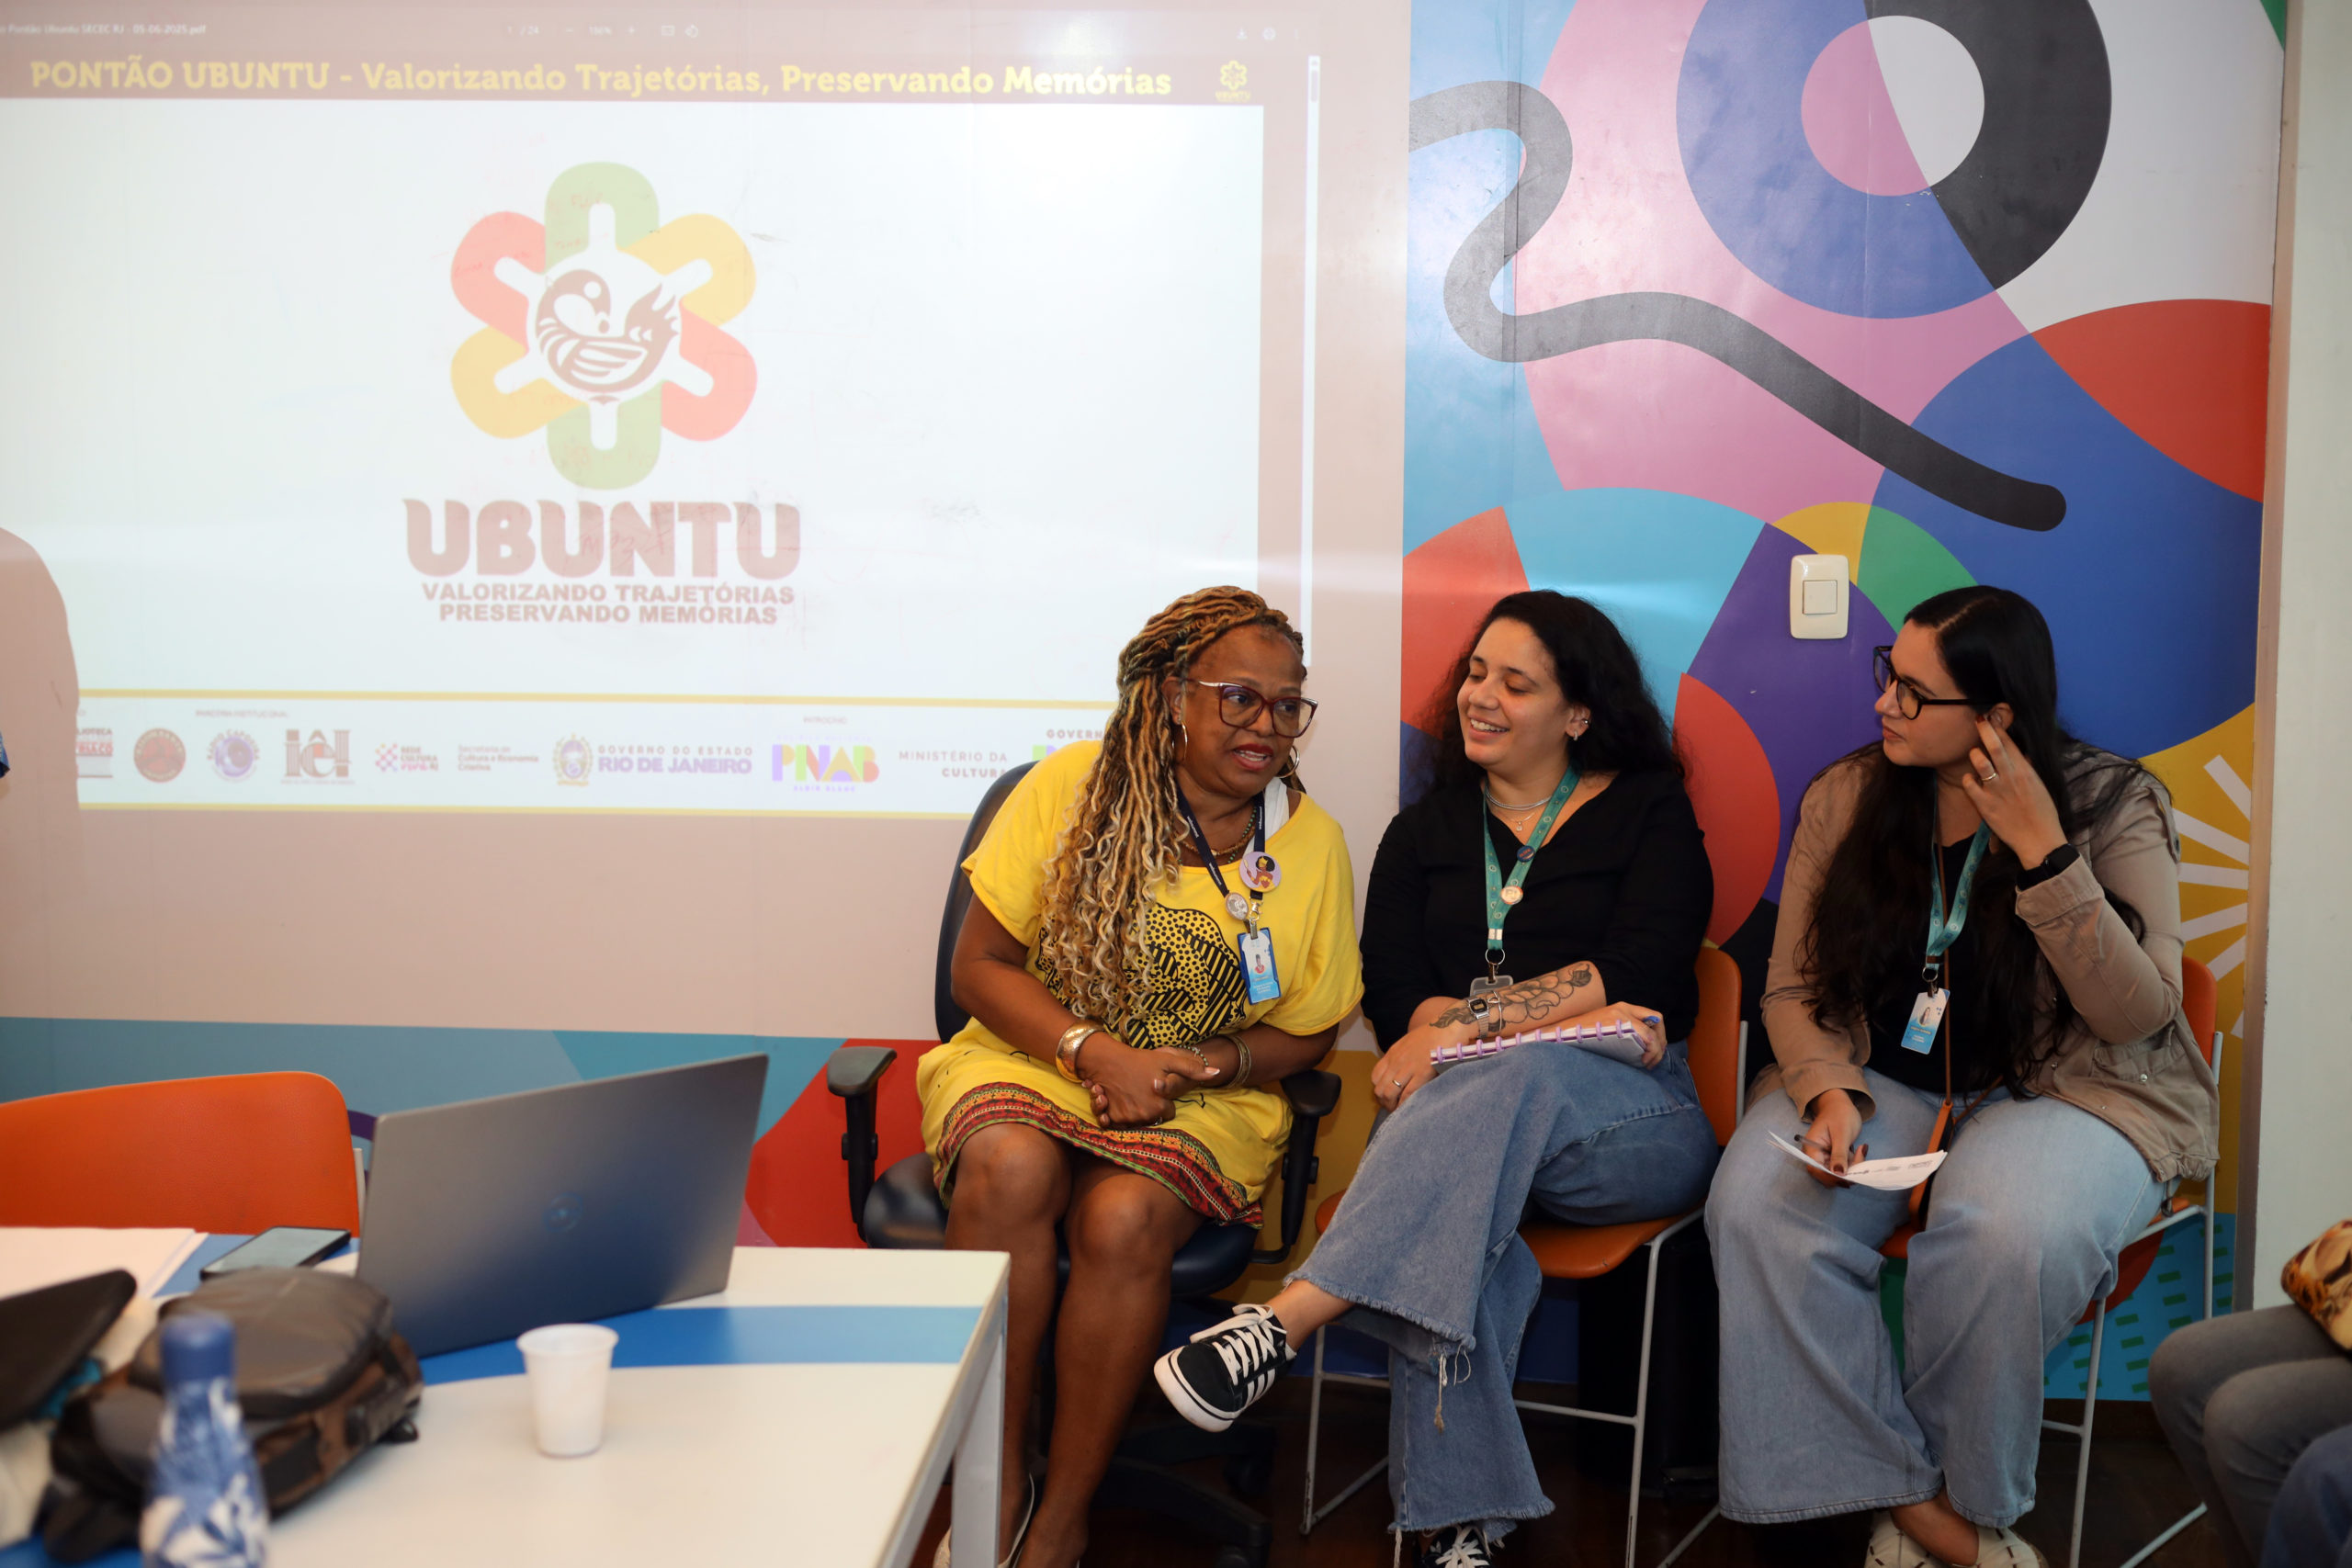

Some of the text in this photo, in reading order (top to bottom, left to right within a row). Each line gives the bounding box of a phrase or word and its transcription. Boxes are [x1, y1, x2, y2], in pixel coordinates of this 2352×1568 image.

[30, 54, 174, 89] PONTÃO
[183, 62, 330, 89] UBUNTU
[361, 62, 567, 91] Valorizando
[575, 62, 770, 97] Trajetórias,
[780, 65, 994, 95] Preservando
[1002, 64, 1172, 96] Memórias
[401, 499, 801, 581] UBUNTU
[422, 581, 796, 604] VALORIZANDO TRAJETÓRIAS
[439, 603, 779, 625] PRESERVANDO MEMÓRIAS
[1046, 729, 1103, 739] GOVERN
[598, 745, 753, 756] GOVERNO DO ESTADO
[899, 750, 1007, 762] MINISTÉRIO DA
[598, 757, 752, 774] RIO DE JANEIRO
[772, 744, 880, 784] PNAB
